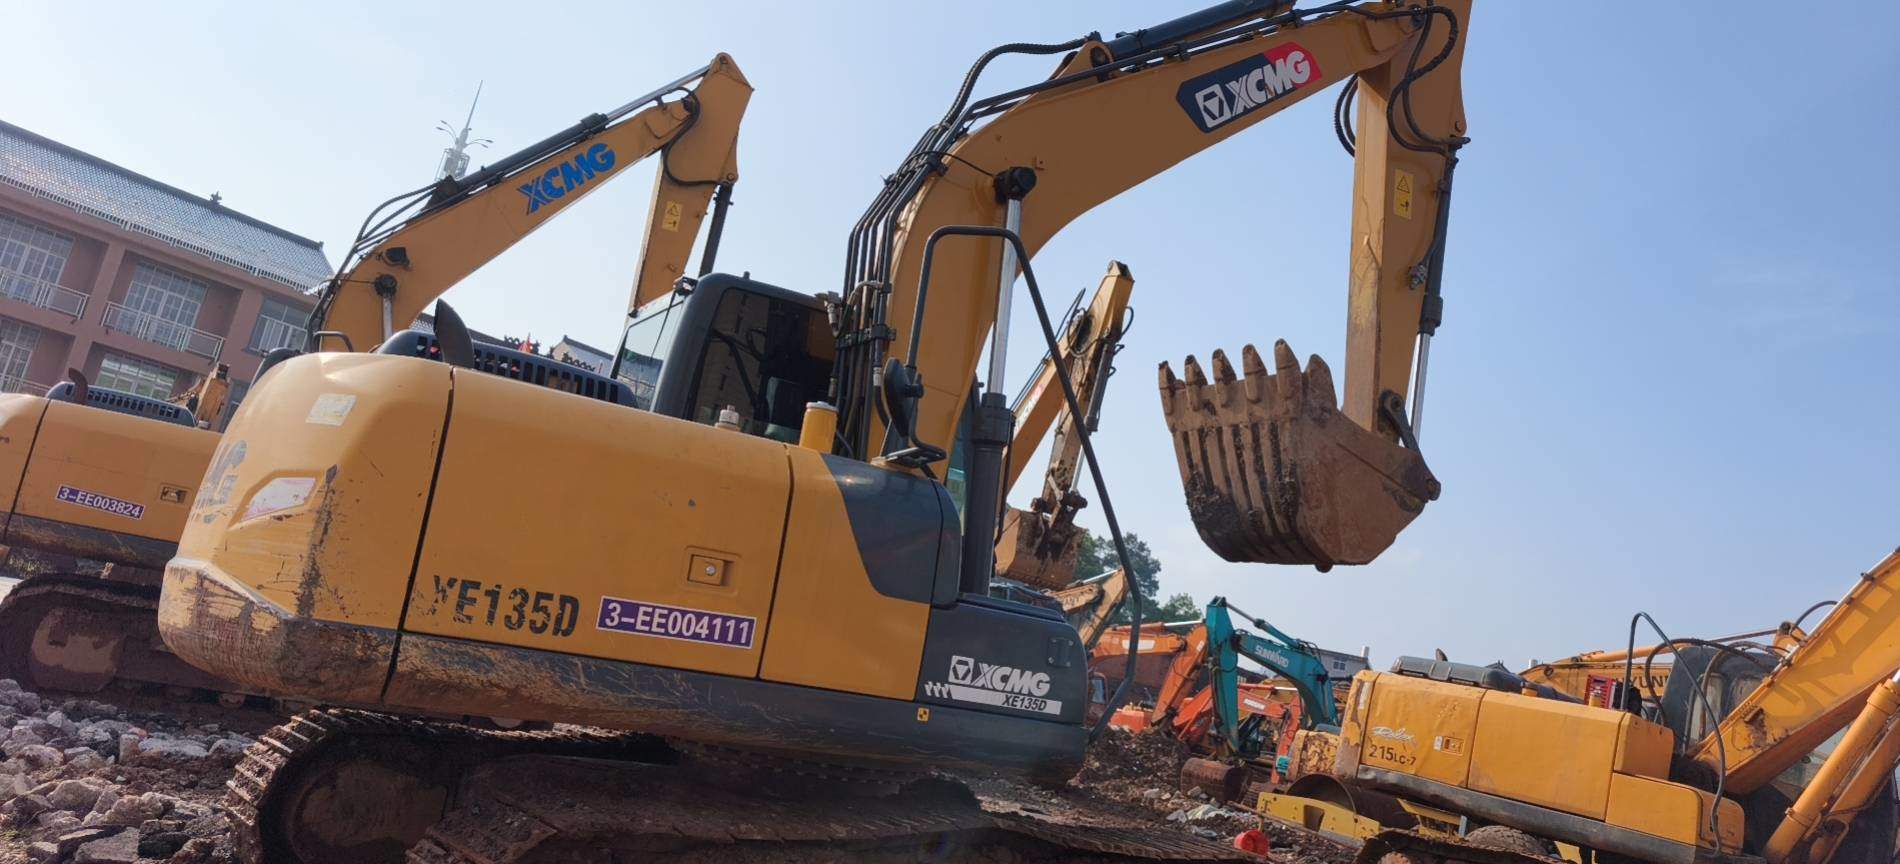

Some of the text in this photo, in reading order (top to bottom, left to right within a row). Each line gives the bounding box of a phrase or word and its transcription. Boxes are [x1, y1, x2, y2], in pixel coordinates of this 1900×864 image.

[1225, 50, 1311, 116] XCMG
[517, 143, 616, 216] XCMG
[59, 487, 141, 517] 3-EE003824
[604, 602, 750, 644] 3-EE004111
[971, 662, 1051, 697] XCMG
[1001, 694, 1048, 711] XE135D
